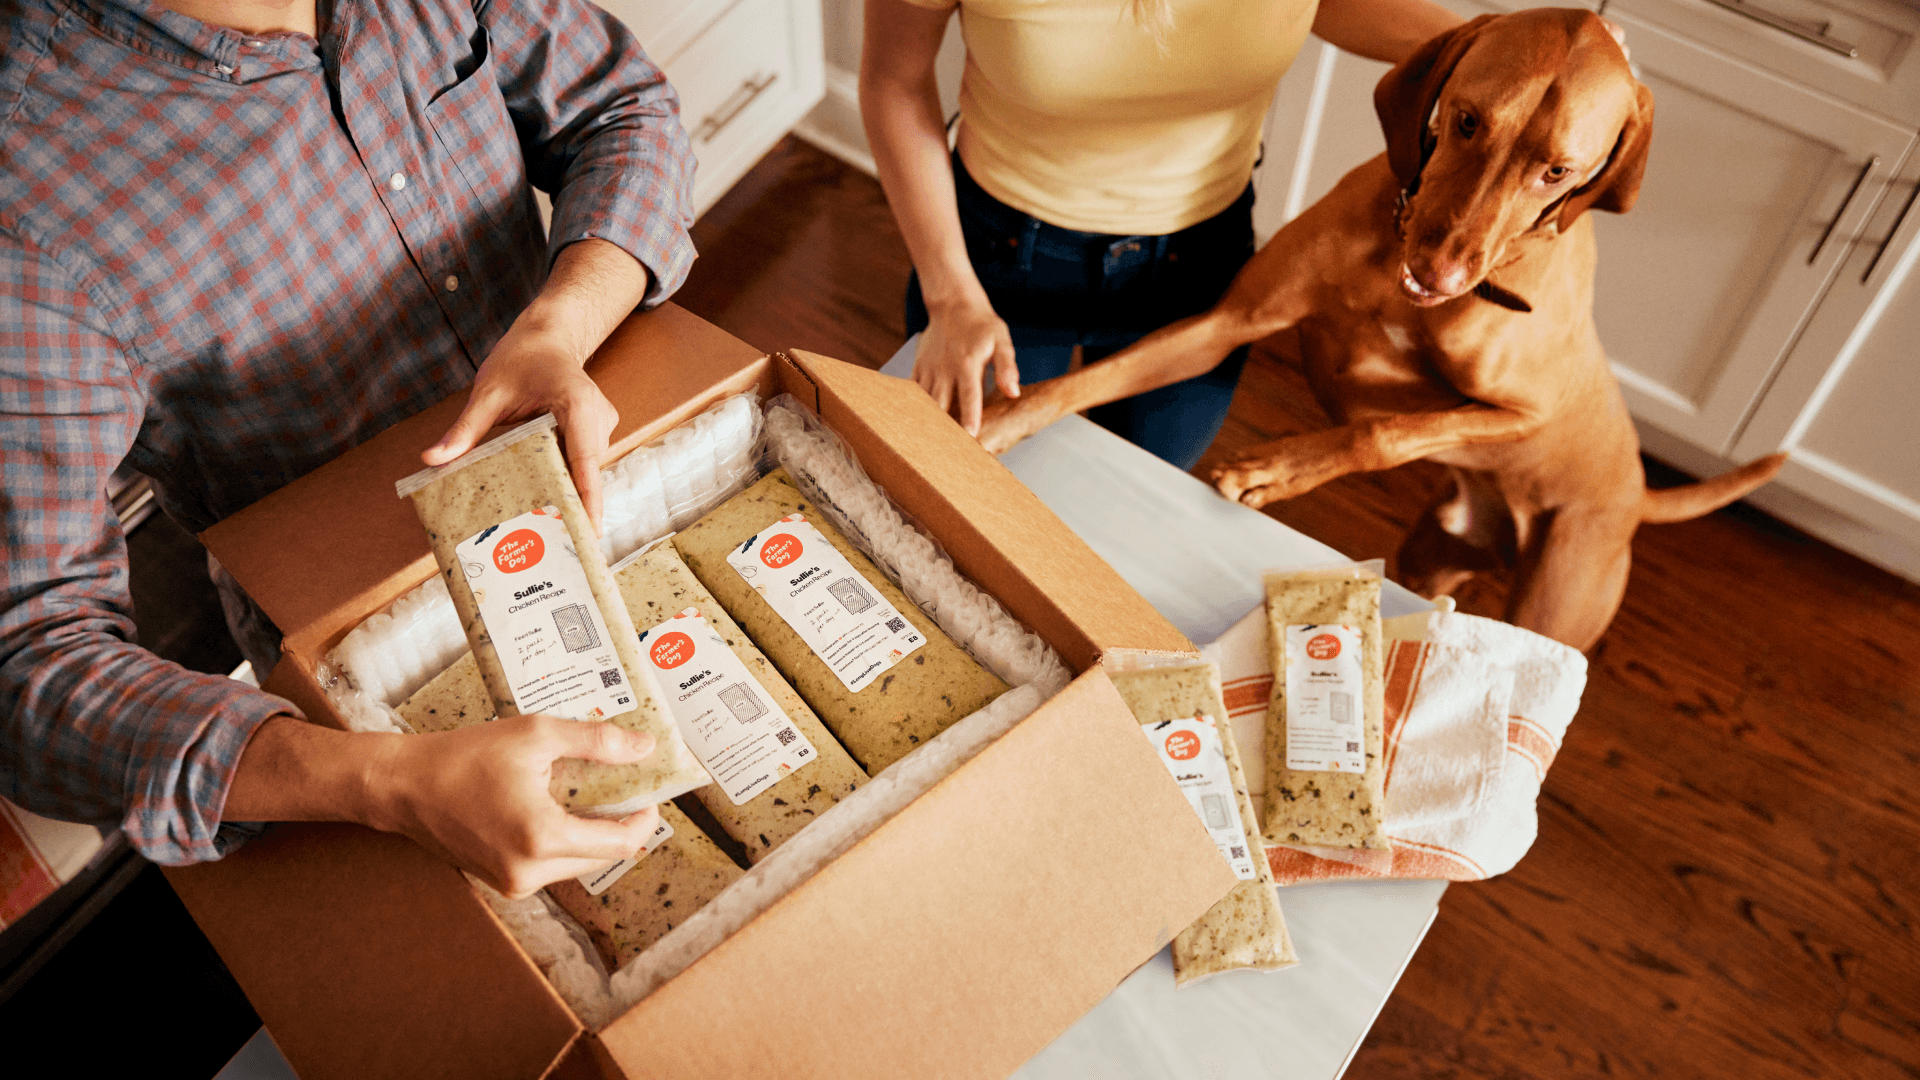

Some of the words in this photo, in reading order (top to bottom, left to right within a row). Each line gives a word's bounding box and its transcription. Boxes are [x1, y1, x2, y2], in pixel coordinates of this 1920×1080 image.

[498, 540, 534, 565] Farmer's
[500, 541, 518, 555] The
[765, 544, 779, 557] The
[766, 540, 792, 564] Farmer's
[506, 555, 526, 568] Dog
[773, 552, 790, 564] Dog
[790, 567, 820, 586] Sullie's
[790, 578, 815, 597] Chicken
[812, 569, 832, 582] Recipe
[514, 581, 553, 600] Sullie's
[508, 598, 540, 614] Chicken
[539, 589, 566, 601] Recipe
[526, 638, 543, 652] packs
[655, 642, 670, 653] The
[656, 639, 684, 663] Farmer's
[522, 655, 531, 666] per
[534, 647, 546, 656] day
[664, 652, 681, 665] Dog
[679, 670, 711, 690] Sullie's
[850, 661, 881, 685] #LongLiveDogs
[678, 685, 704, 701] Chicken
[702, 674, 724, 687] Recipe
[617, 697, 629, 705] E8
[704, 717, 717, 731] packs
[798, 749, 809, 757] E8
[735, 774, 769, 797] #LongLiveDogs
[655, 827, 665, 835] E8
[590, 859, 625, 887] #LongLiveDogs
